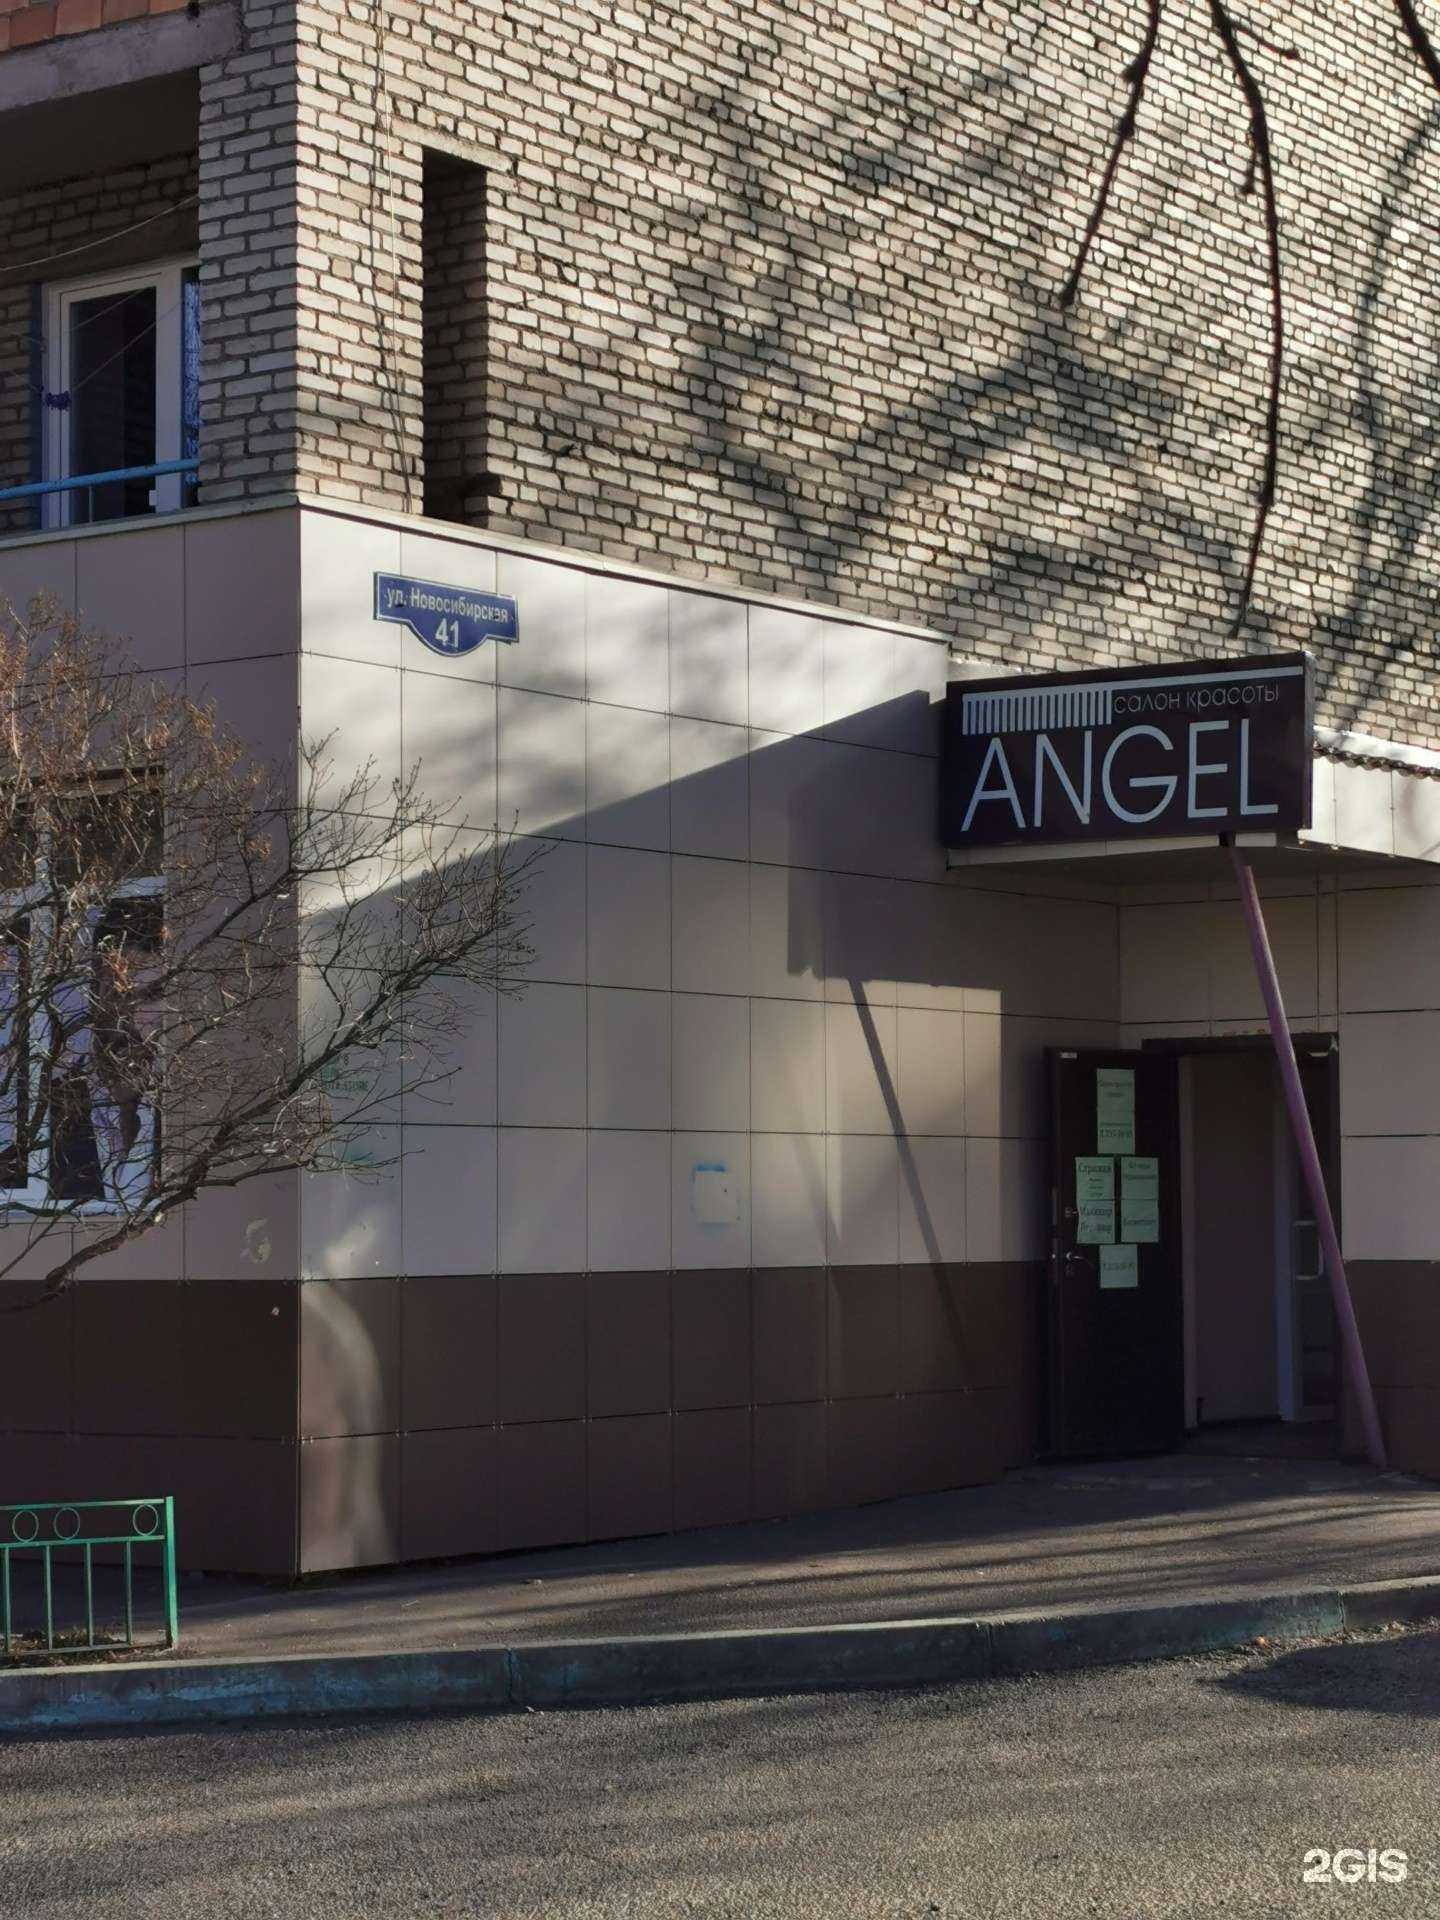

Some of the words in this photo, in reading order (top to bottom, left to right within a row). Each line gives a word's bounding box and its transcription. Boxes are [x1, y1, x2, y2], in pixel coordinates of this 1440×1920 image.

[387, 587, 408, 608] ул.
[411, 587, 509, 622] Новосибирская
[435, 617, 460, 648] 41
[1115, 693, 1181, 715] салон
[1187, 684, 1280, 711] красоты
[961, 719, 1280, 832] ANGEL
